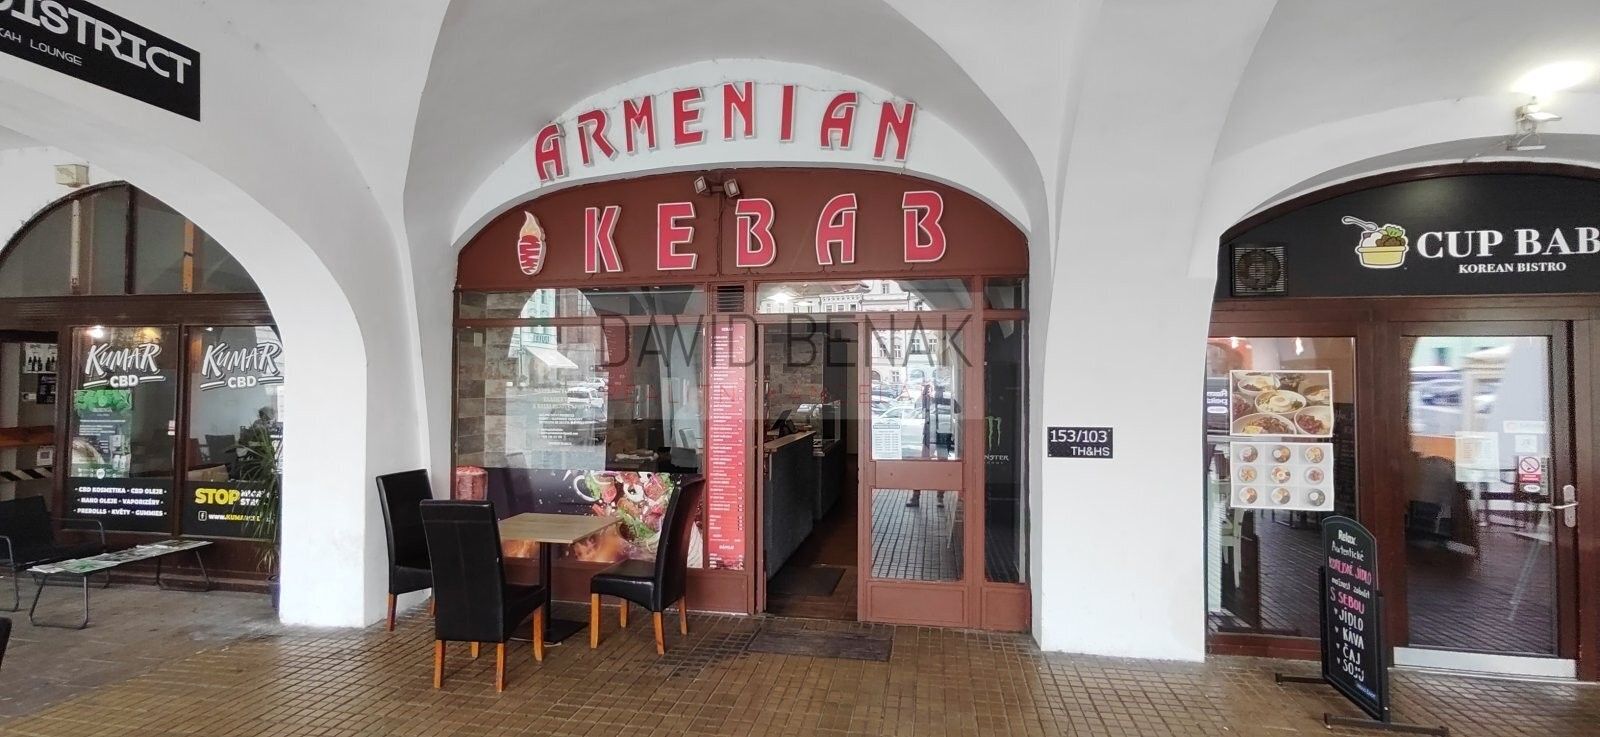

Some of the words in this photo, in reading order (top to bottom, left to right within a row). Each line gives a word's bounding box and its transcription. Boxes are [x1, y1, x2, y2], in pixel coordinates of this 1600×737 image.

[0, 0, 192, 84] ISTRICT
[29, 38, 83, 66] LOUNGE
[534, 80, 917, 183] ARMENIAN
[584, 190, 947, 273] KEBAB
[1416, 229, 1503, 259] CUP
[1514, 227, 1600, 256] BAB
[1458, 263, 1514, 274] KOREAN
[1517, 261, 1567, 273] BISTRO
[84, 343, 162, 377] KUMAR
[201, 343, 281, 379] KUMAR
[109, 374, 139, 388] CBD
[227, 376, 257, 389] CBD
[1050, 429, 1107, 443] 153/103
[1070, 446, 1110, 457] TH&HS
[195, 487, 240, 505] STOP
[1330, 586, 1336, 602] S
[1337, 591, 1365, 615] SEBOU
[1338, 606, 1364, 632] JÍDLO
[1342, 626, 1364, 650] KÁVA
[1342, 642, 1361, 665] ČAJ
